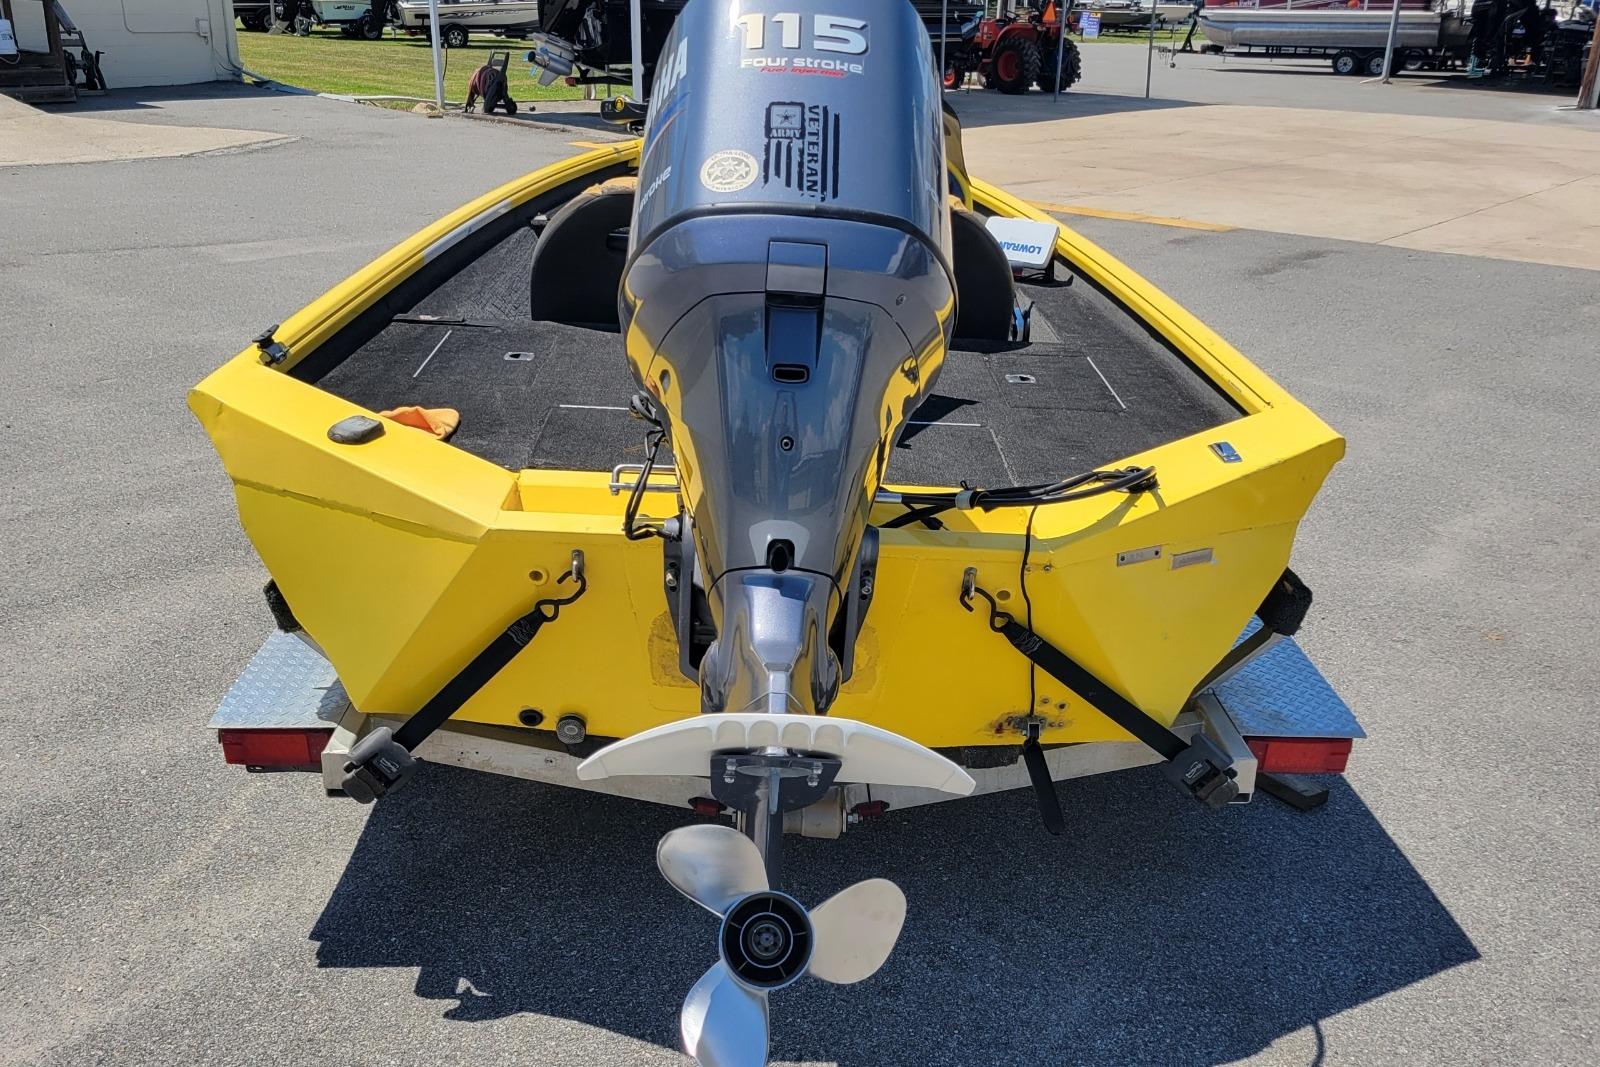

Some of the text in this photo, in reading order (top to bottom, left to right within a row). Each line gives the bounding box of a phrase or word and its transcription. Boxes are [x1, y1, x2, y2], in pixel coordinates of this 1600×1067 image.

[737, 13, 868, 55] 115
[740, 57, 863, 74] Four stroke
[760, 66, 788, 74] Fuel
[770, 129, 801, 138] ARMY
[806, 104, 820, 192] VETERAN
[1000, 241, 1042, 255] LOWRAN
